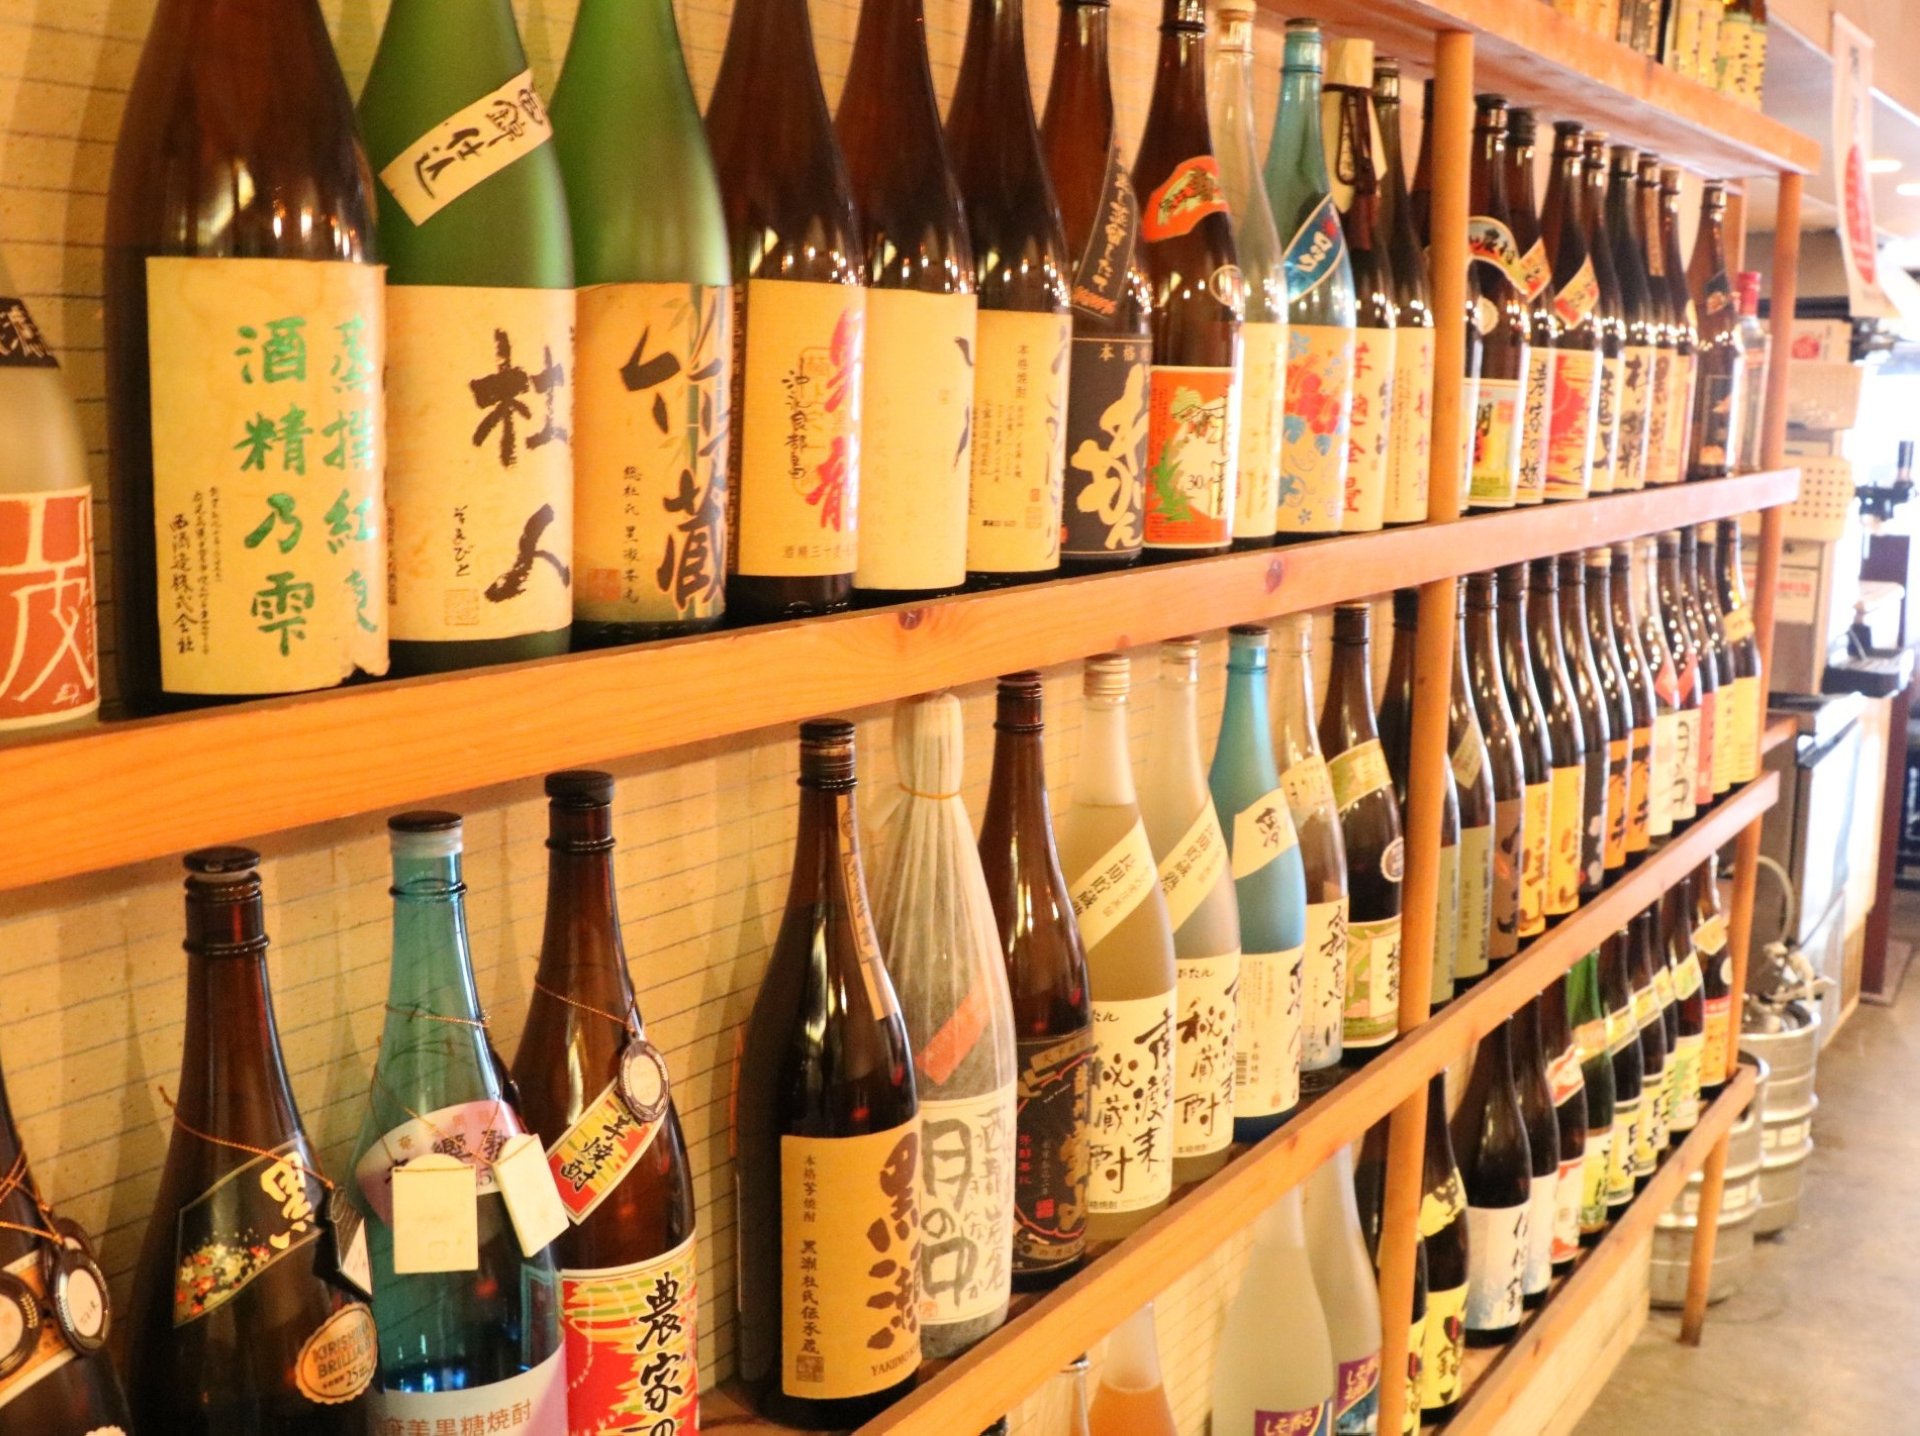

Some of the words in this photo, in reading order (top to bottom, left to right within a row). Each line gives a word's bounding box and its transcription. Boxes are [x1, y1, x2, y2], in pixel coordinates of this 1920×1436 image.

[234, 316, 315, 656] 酒精乃雫
[560, 1113, 629, 1192] 芋焼酎
[922, 1119, 978, 1311] 月の中
